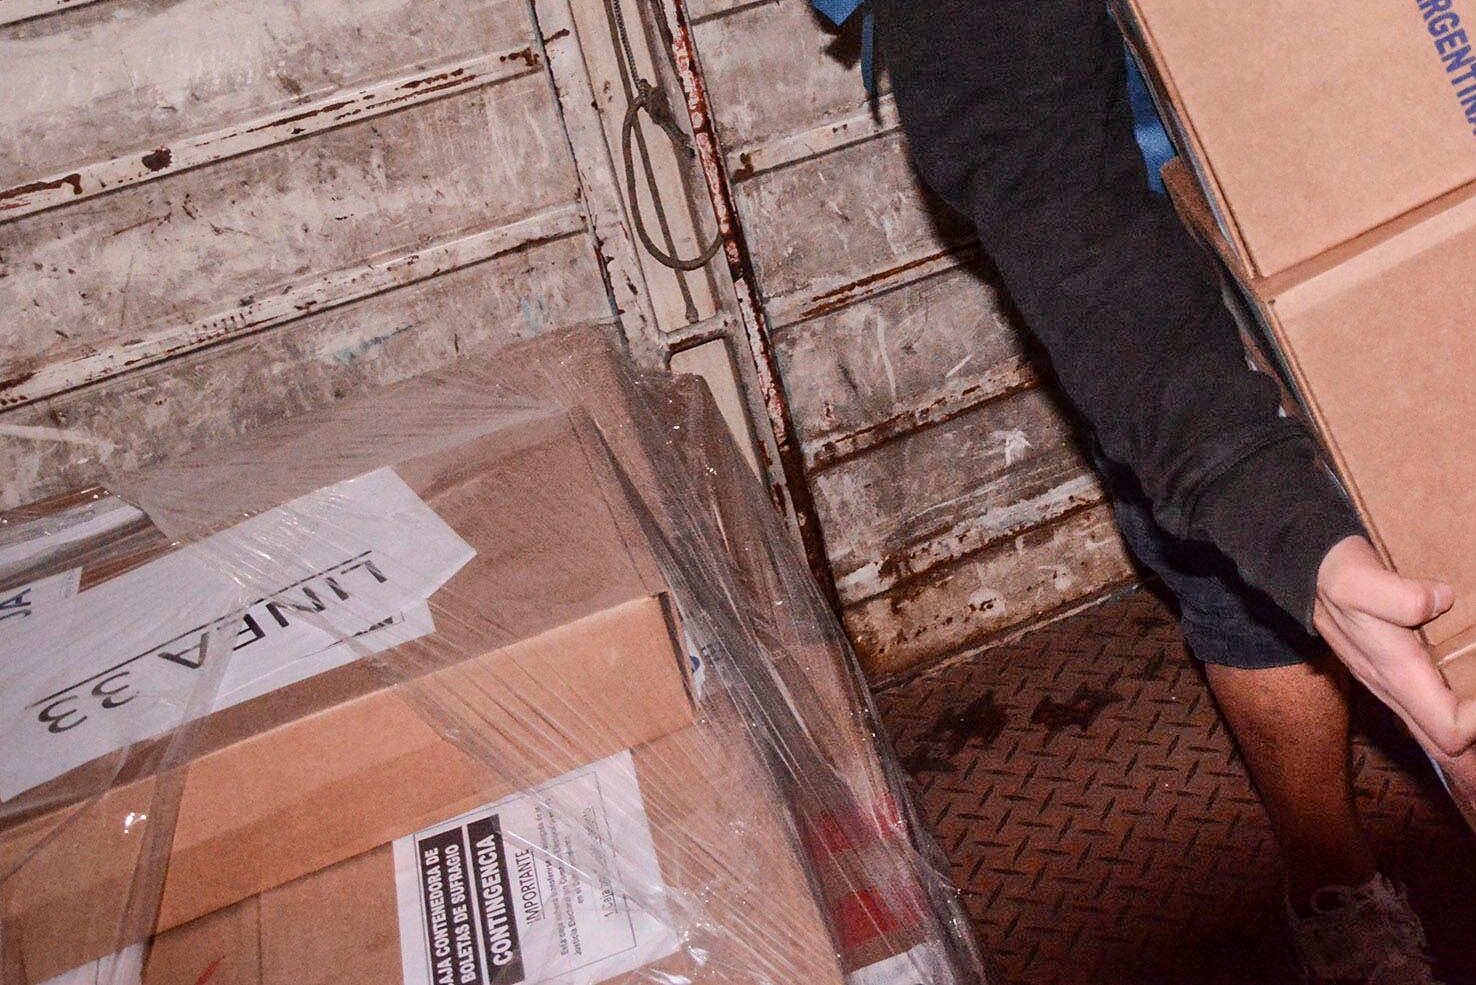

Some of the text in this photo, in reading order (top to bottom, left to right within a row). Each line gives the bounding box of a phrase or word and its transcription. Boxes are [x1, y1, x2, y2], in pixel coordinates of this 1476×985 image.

[37, 558, 388, 735] LINEA 33
[423, 846, 452, 985] AJA CONTENEDORA DE
[444, 843, 478, 985] BOLETAS DE SUFRAGIO
[475, 833, 514, 966] CONTINGENCIA
[514, 848, 543, 926] IMPORTANTE
